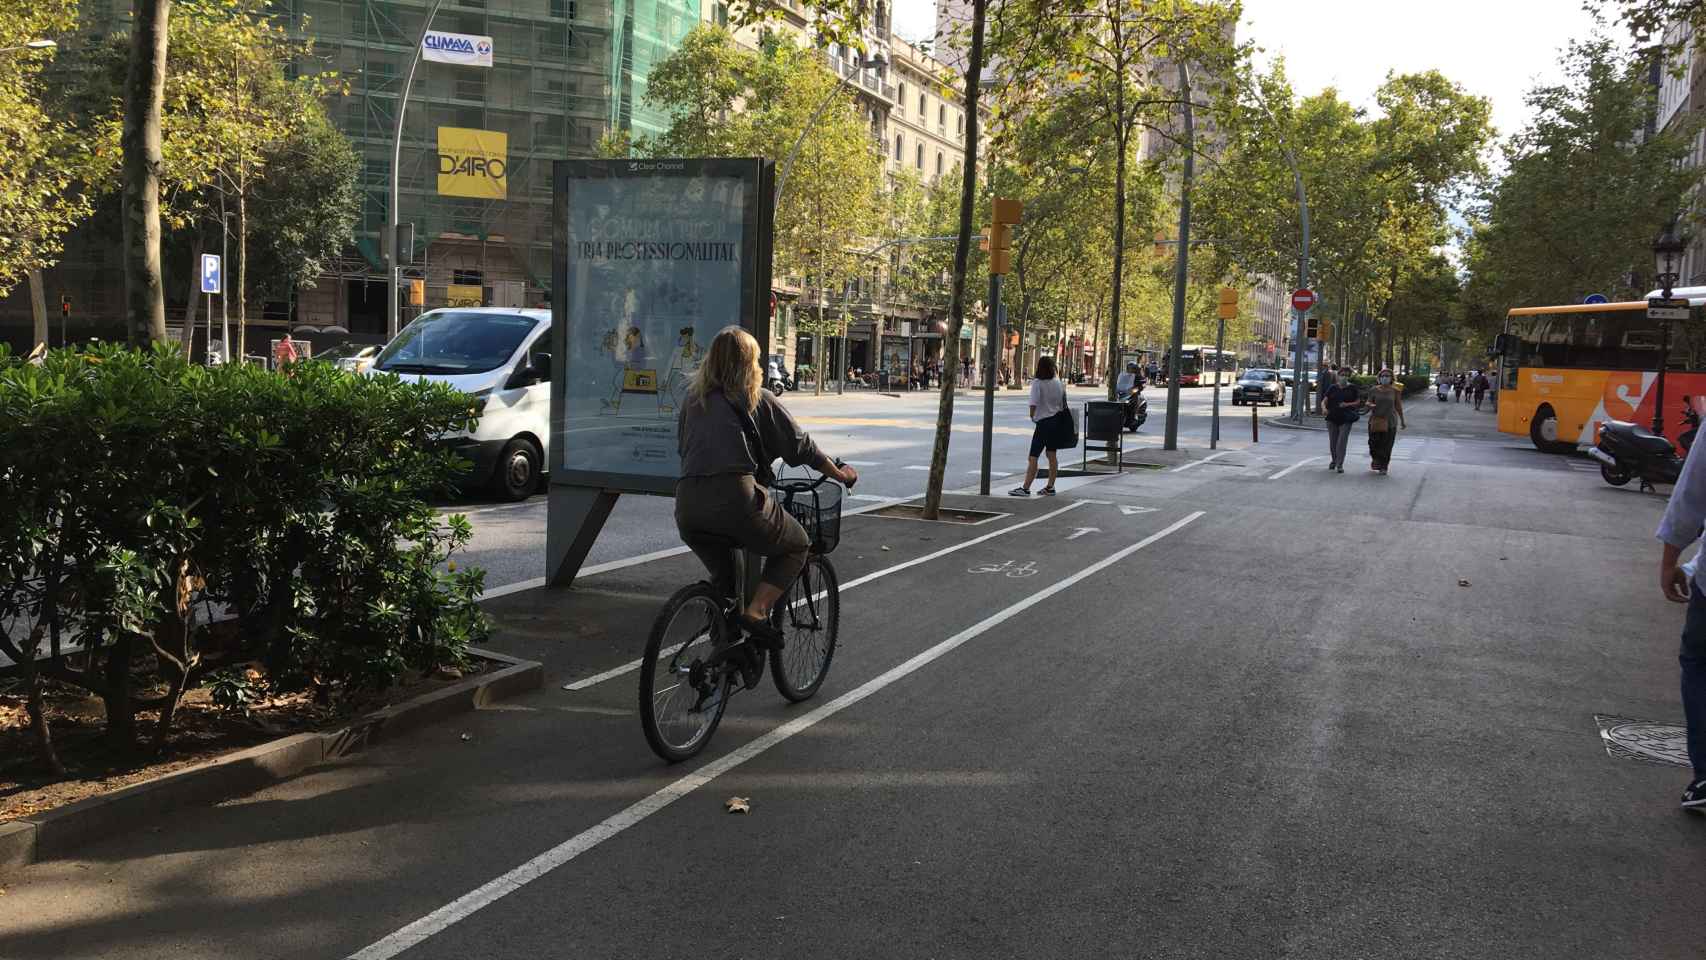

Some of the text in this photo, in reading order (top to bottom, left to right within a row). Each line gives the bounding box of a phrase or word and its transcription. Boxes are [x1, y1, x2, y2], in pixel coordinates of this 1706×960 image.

[424, 35, 474, 52] CLIMAVA
[638, 160, 684, 170] Clear Channel
[205, 257, 218, 279] P
